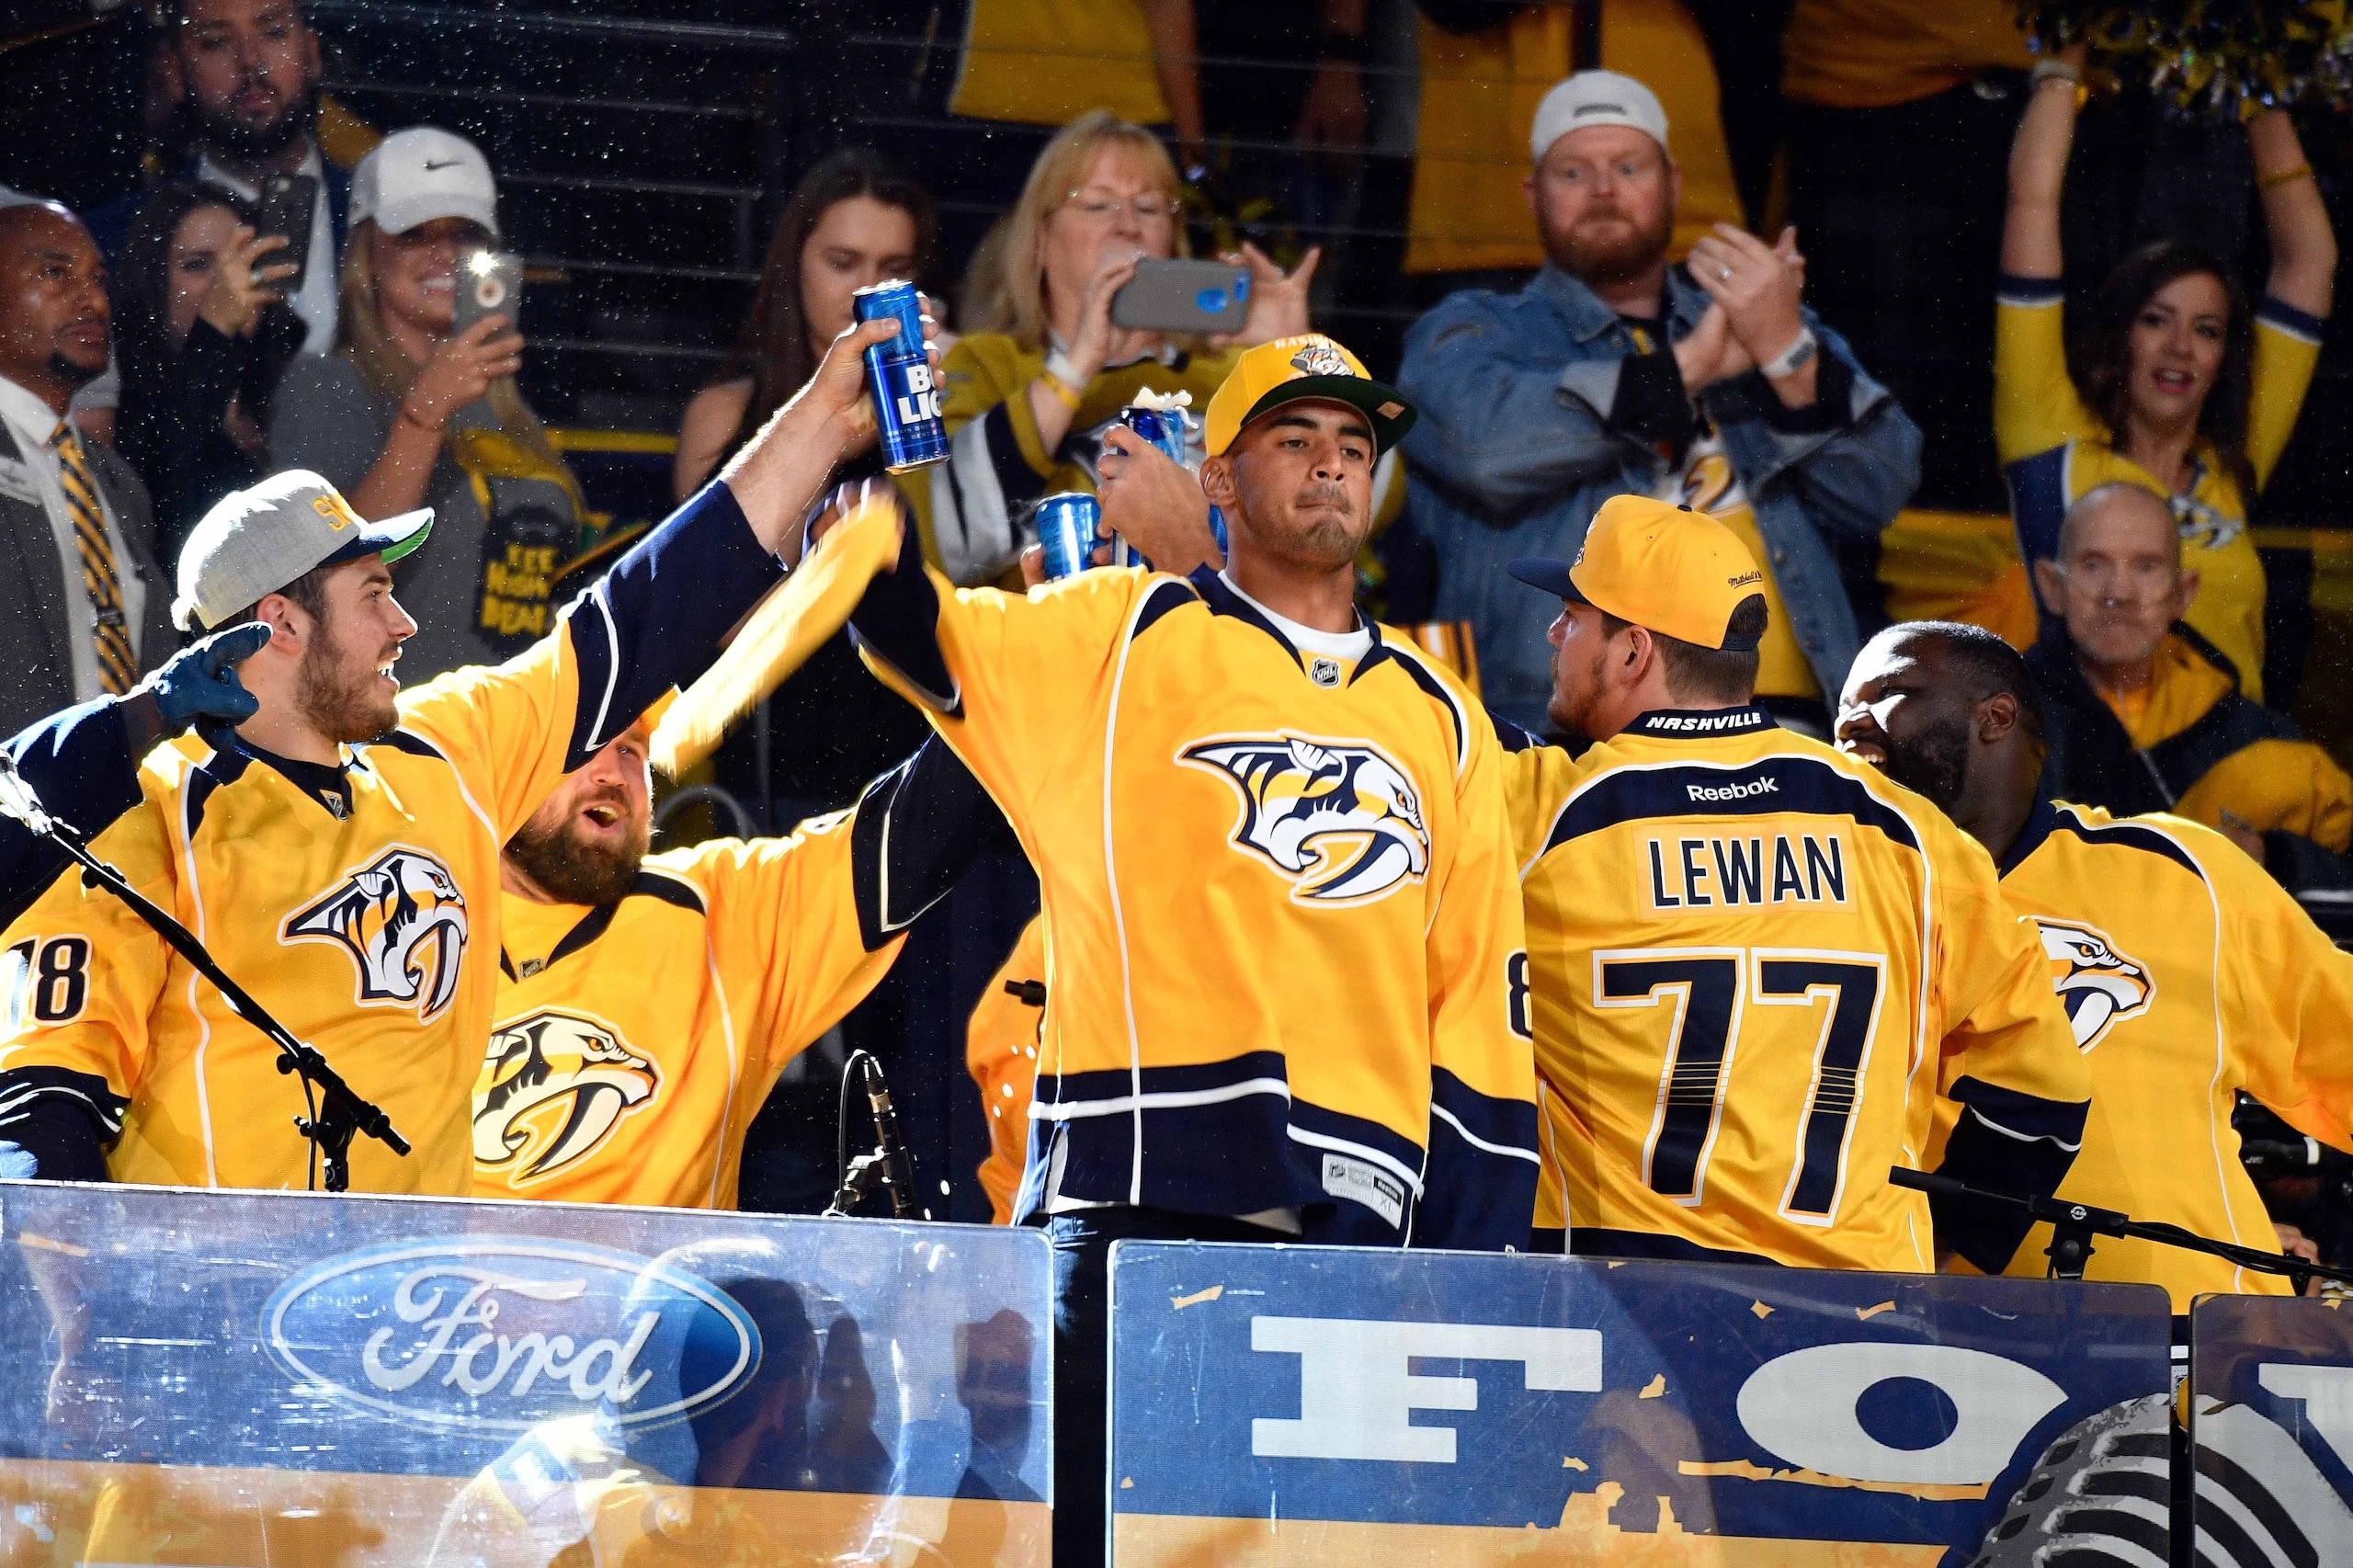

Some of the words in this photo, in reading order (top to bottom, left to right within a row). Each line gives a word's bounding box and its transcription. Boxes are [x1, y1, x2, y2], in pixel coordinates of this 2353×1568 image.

[1645, 712, 1762, 731] NASHVILLE
[1686, 777, 1780, 801] Reebok
[1647, 834, 1847, 909] LEWAN
[1593, 947, 1888, 1229] 77
[362, 1266, 661, 1403] Ford
